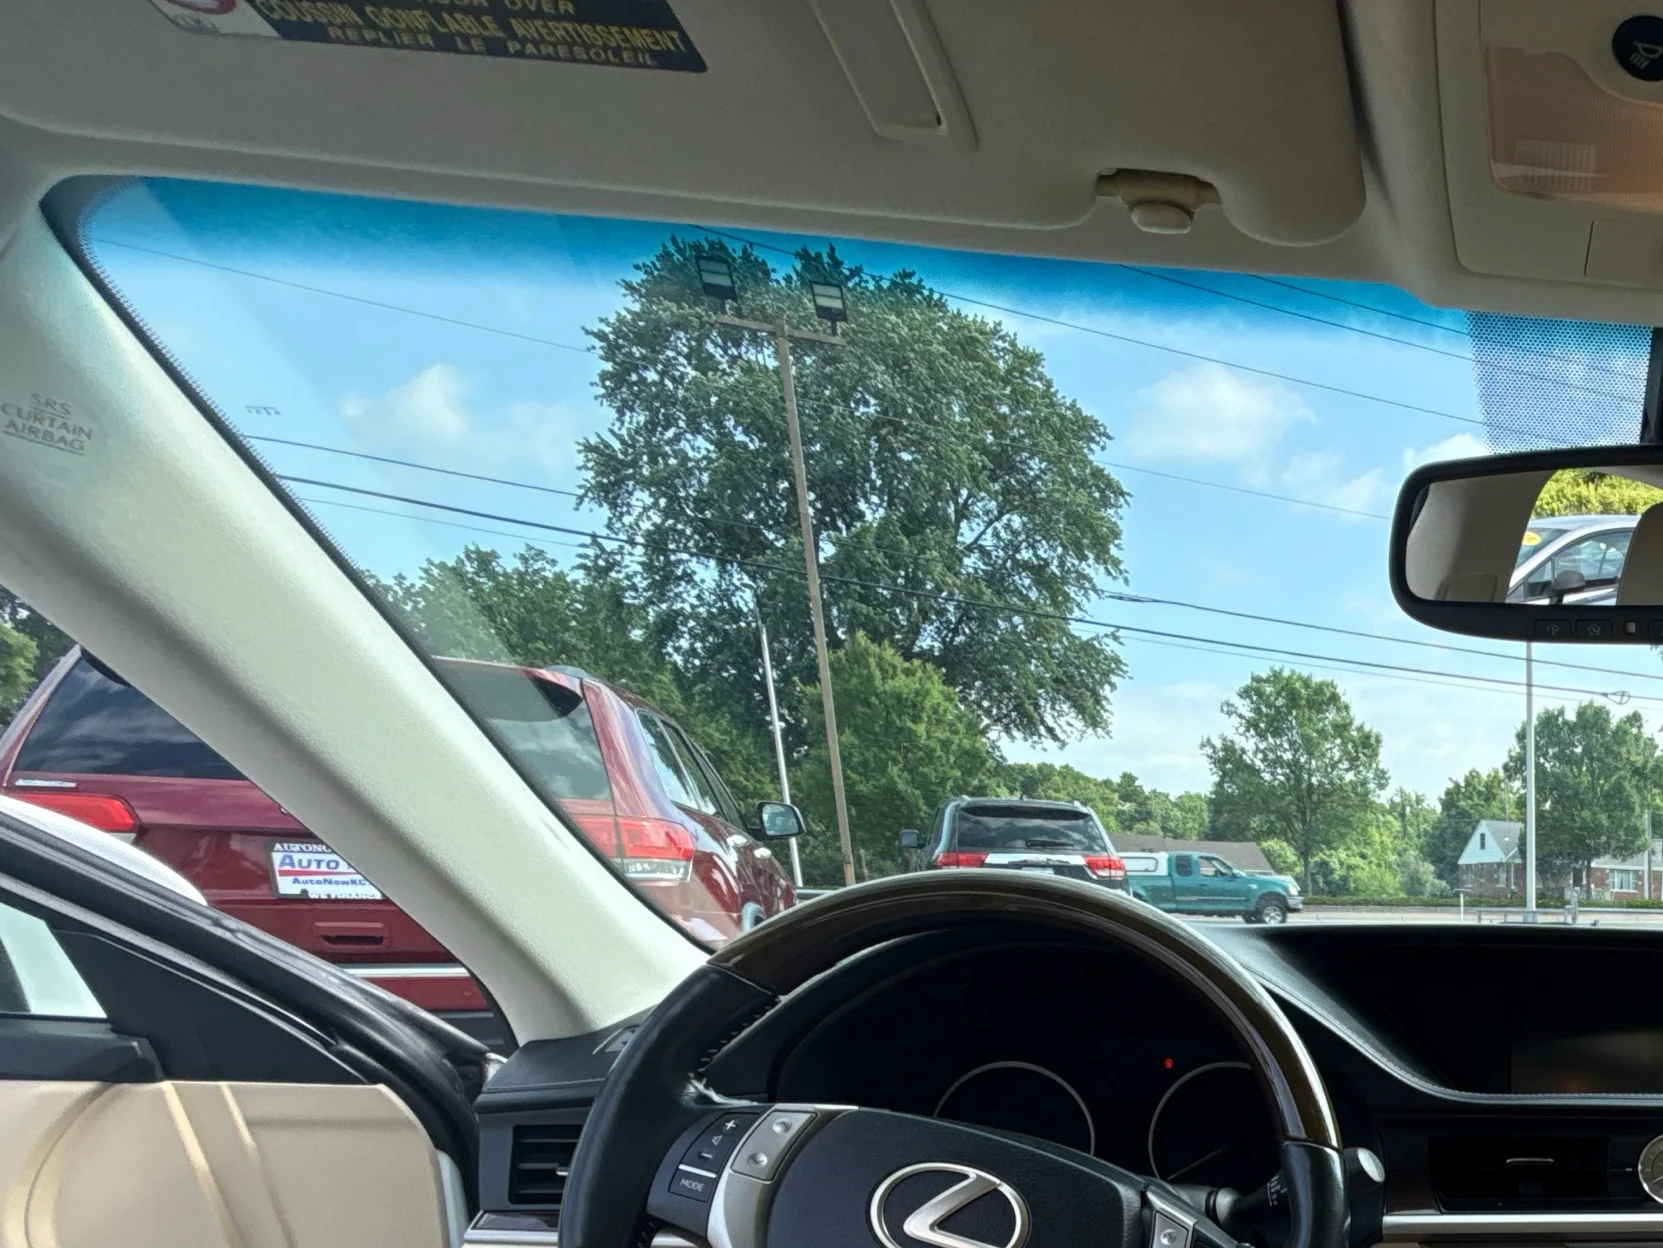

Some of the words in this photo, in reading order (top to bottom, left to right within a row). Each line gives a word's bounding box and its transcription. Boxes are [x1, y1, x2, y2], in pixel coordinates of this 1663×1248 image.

[256, 0, 364, 26] COUSSIN
[364, 4, 506, 38] GONFLABLE
[508, 16, 687, 52] AVERTISSEMENT
[326, 25, 436, 48] REPLIER
[455, 35, 486, 52] LE
[505, 39, 658, 67] PARESOLEIL
[31, 393, 72, 416] SRS
[1, 402, 94, 440] CURTAIN
[4, 420, 85, 451] AIRBAG
[273, 843, 332, 853] AUTONO
[292, 877, 368, 886] AutoNowKC
[679, 1178, 705, 1192] MODE
